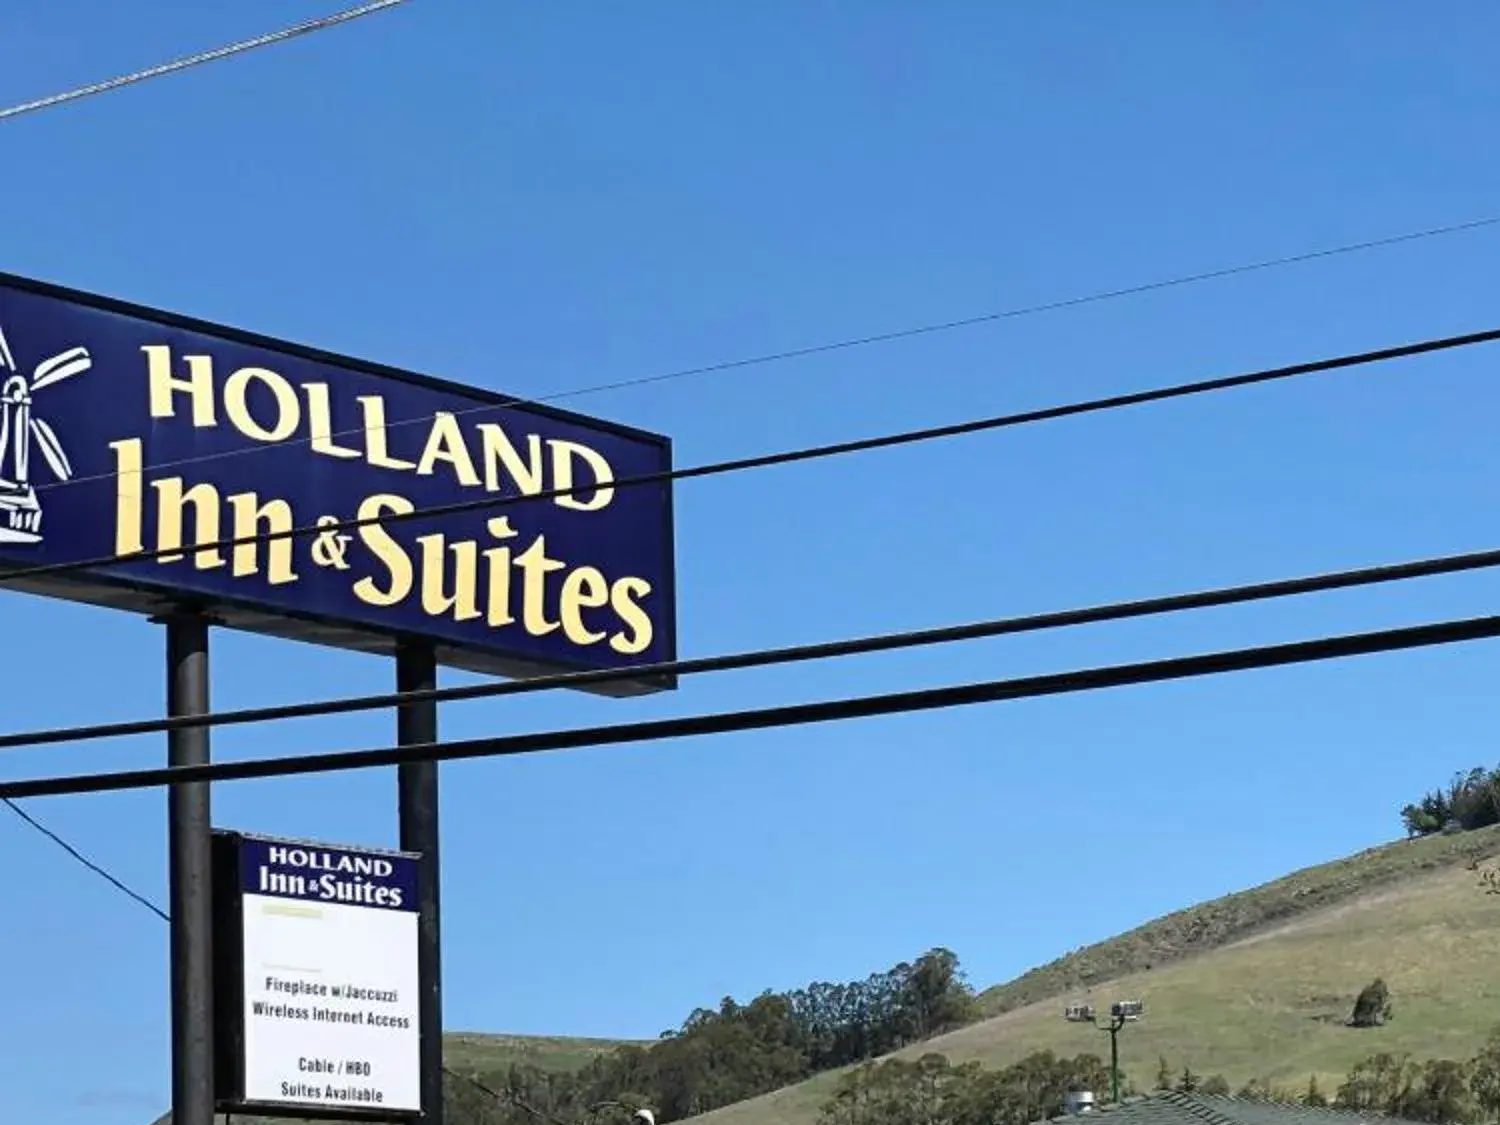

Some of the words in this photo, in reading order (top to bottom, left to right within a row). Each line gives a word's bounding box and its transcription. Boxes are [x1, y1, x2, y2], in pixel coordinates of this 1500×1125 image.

[140, 344, 615, 511] HOLLAND
[109, 437, 298, 585] Inn
[311, 515, 352, 570] &
[353, 494, 653, 654] Suites
[269, 846, 393, 877] HOLLAND
[259, 865, 306, 895] Inn
[308, 879, 319, 893] &
[319, 873, 403, 907] Suites
[265, 976, 327, 997] Fireplace
[252, 1001, 309, 1020] Wireless
[312, 1006, 363, 1025] Internet
[367, 1011, 410, 1029] Access
[298, 1056, 335, 1074] Cable
[345, 1060, 371, 1077] HBO
[281, 1080, 321, 1099] Suites
[325, 1083, 384, 1103] Available
